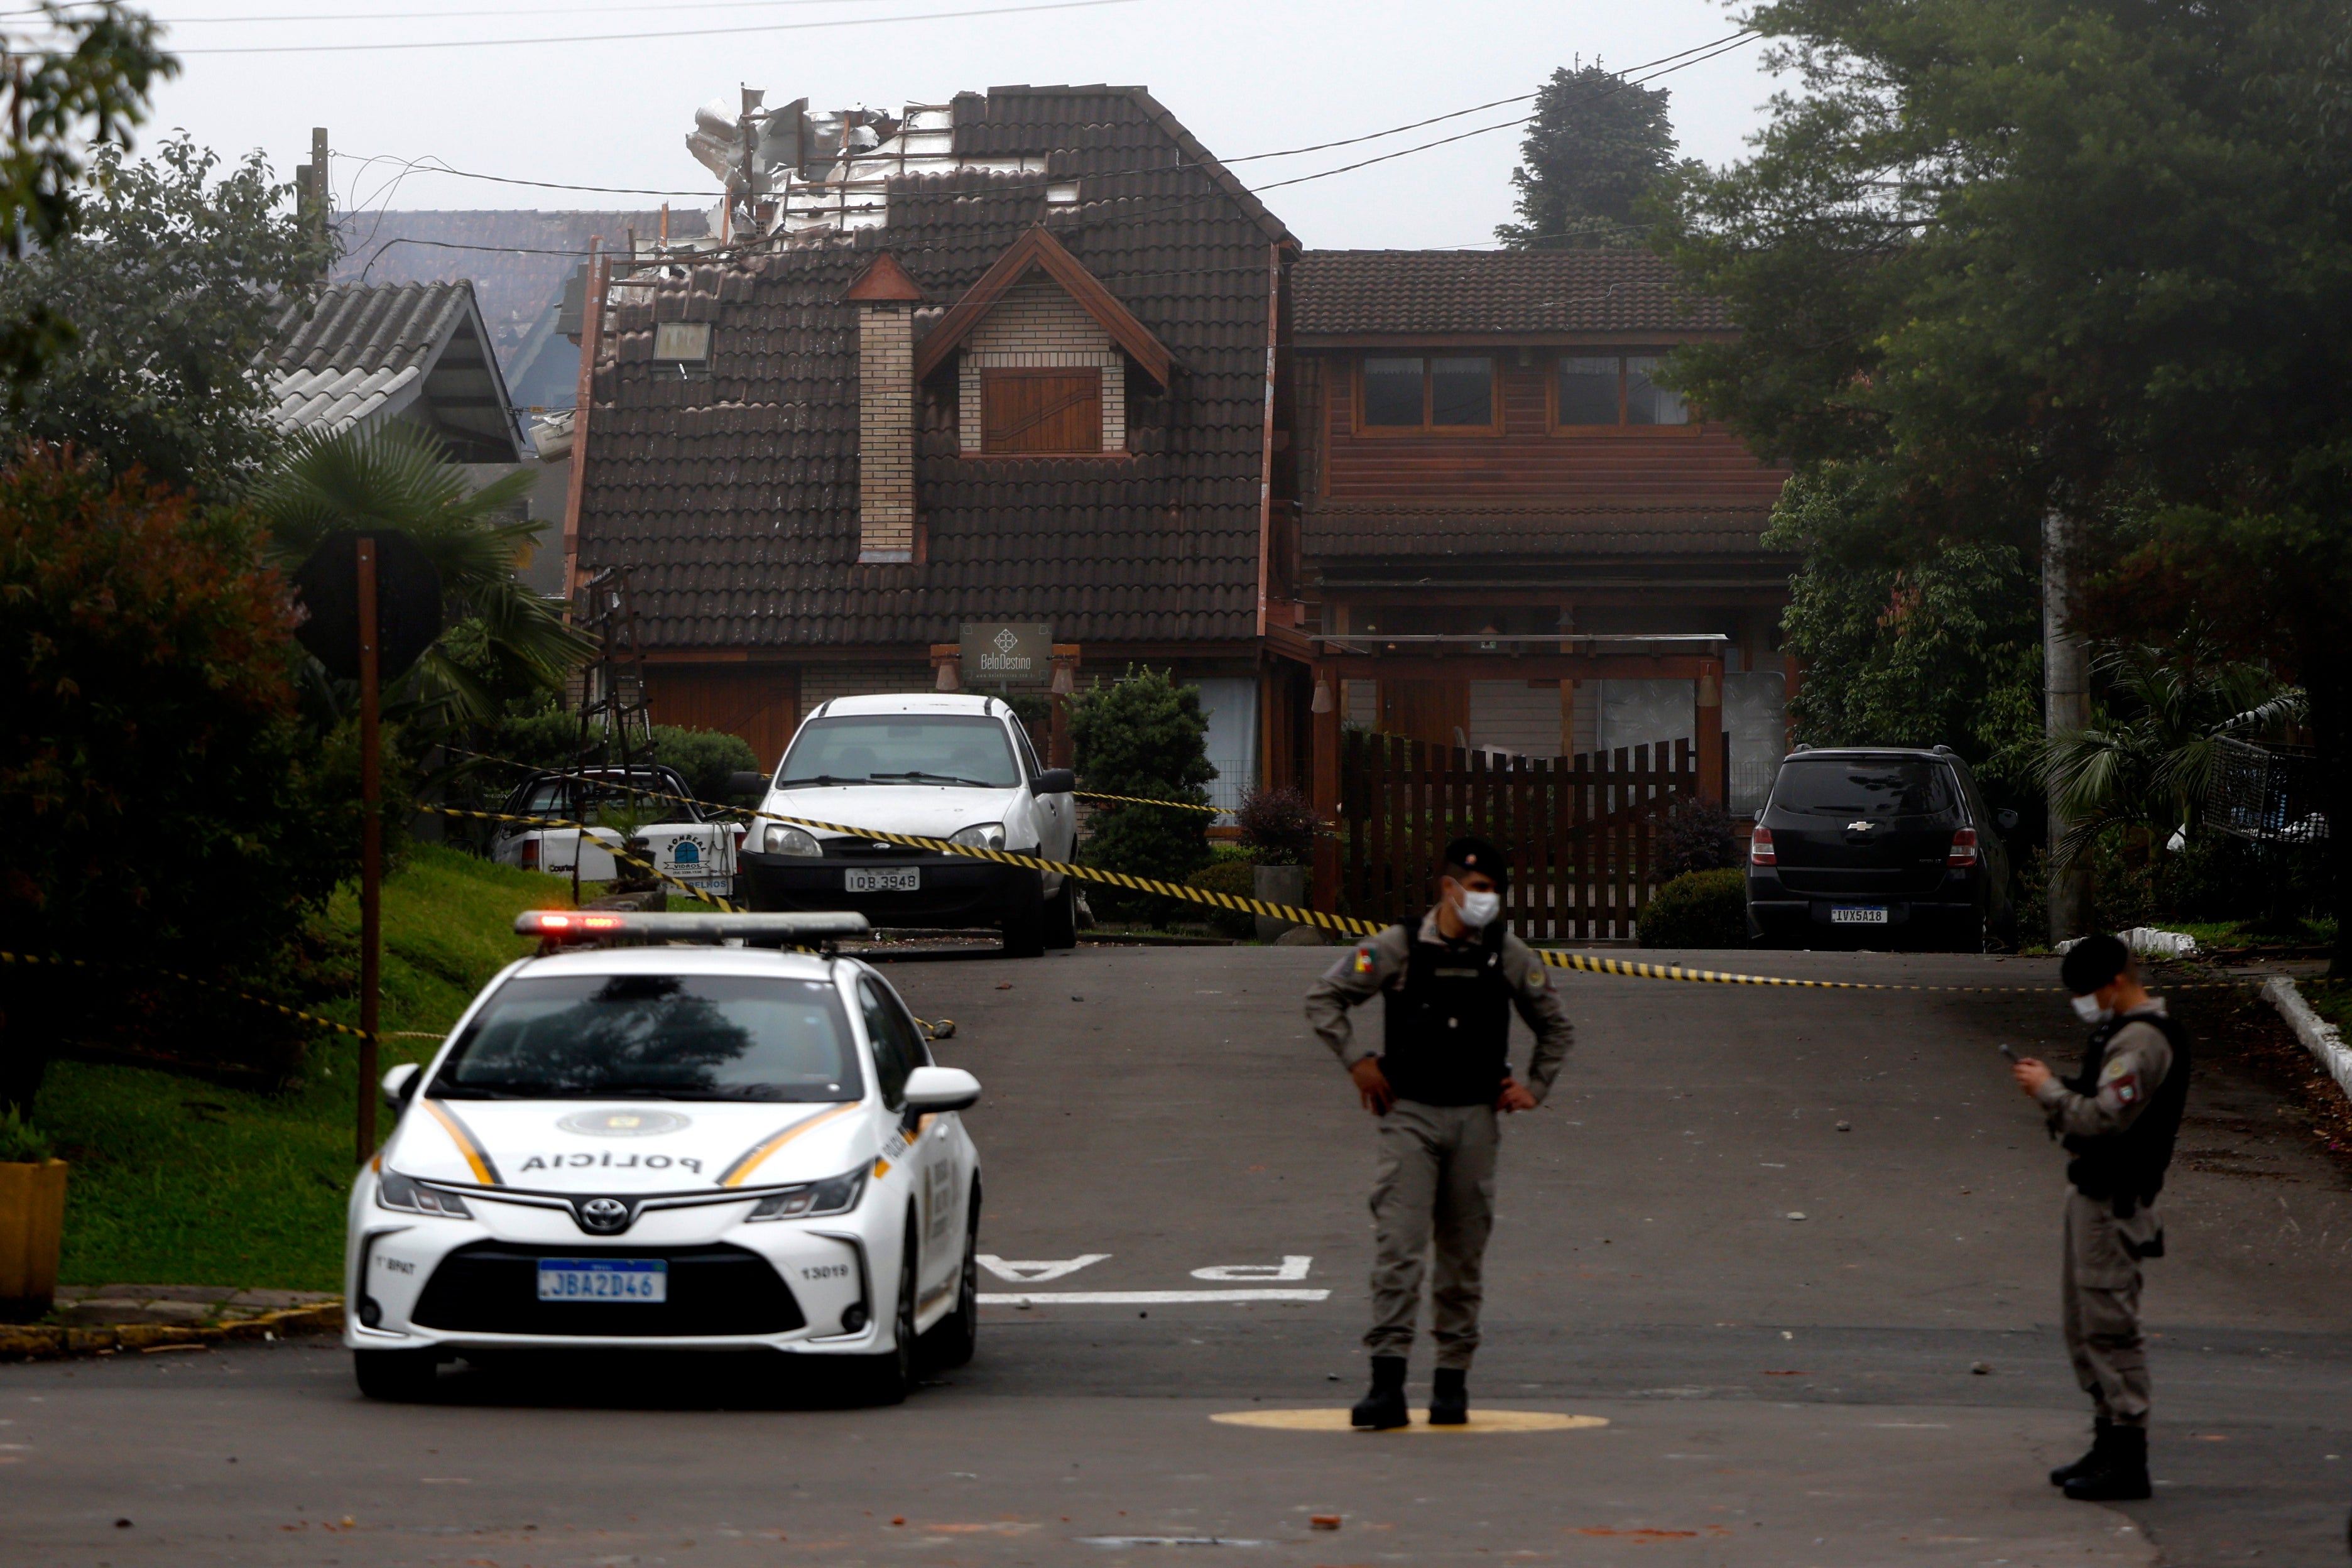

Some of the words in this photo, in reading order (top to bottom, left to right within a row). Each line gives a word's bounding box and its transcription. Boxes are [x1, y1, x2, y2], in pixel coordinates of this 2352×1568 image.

[667, 834, 707, 852] MONREAL
[1836, 910, 1882, 922] IVX5A18
[553, 1273, 653, 1297] JBA2D46
